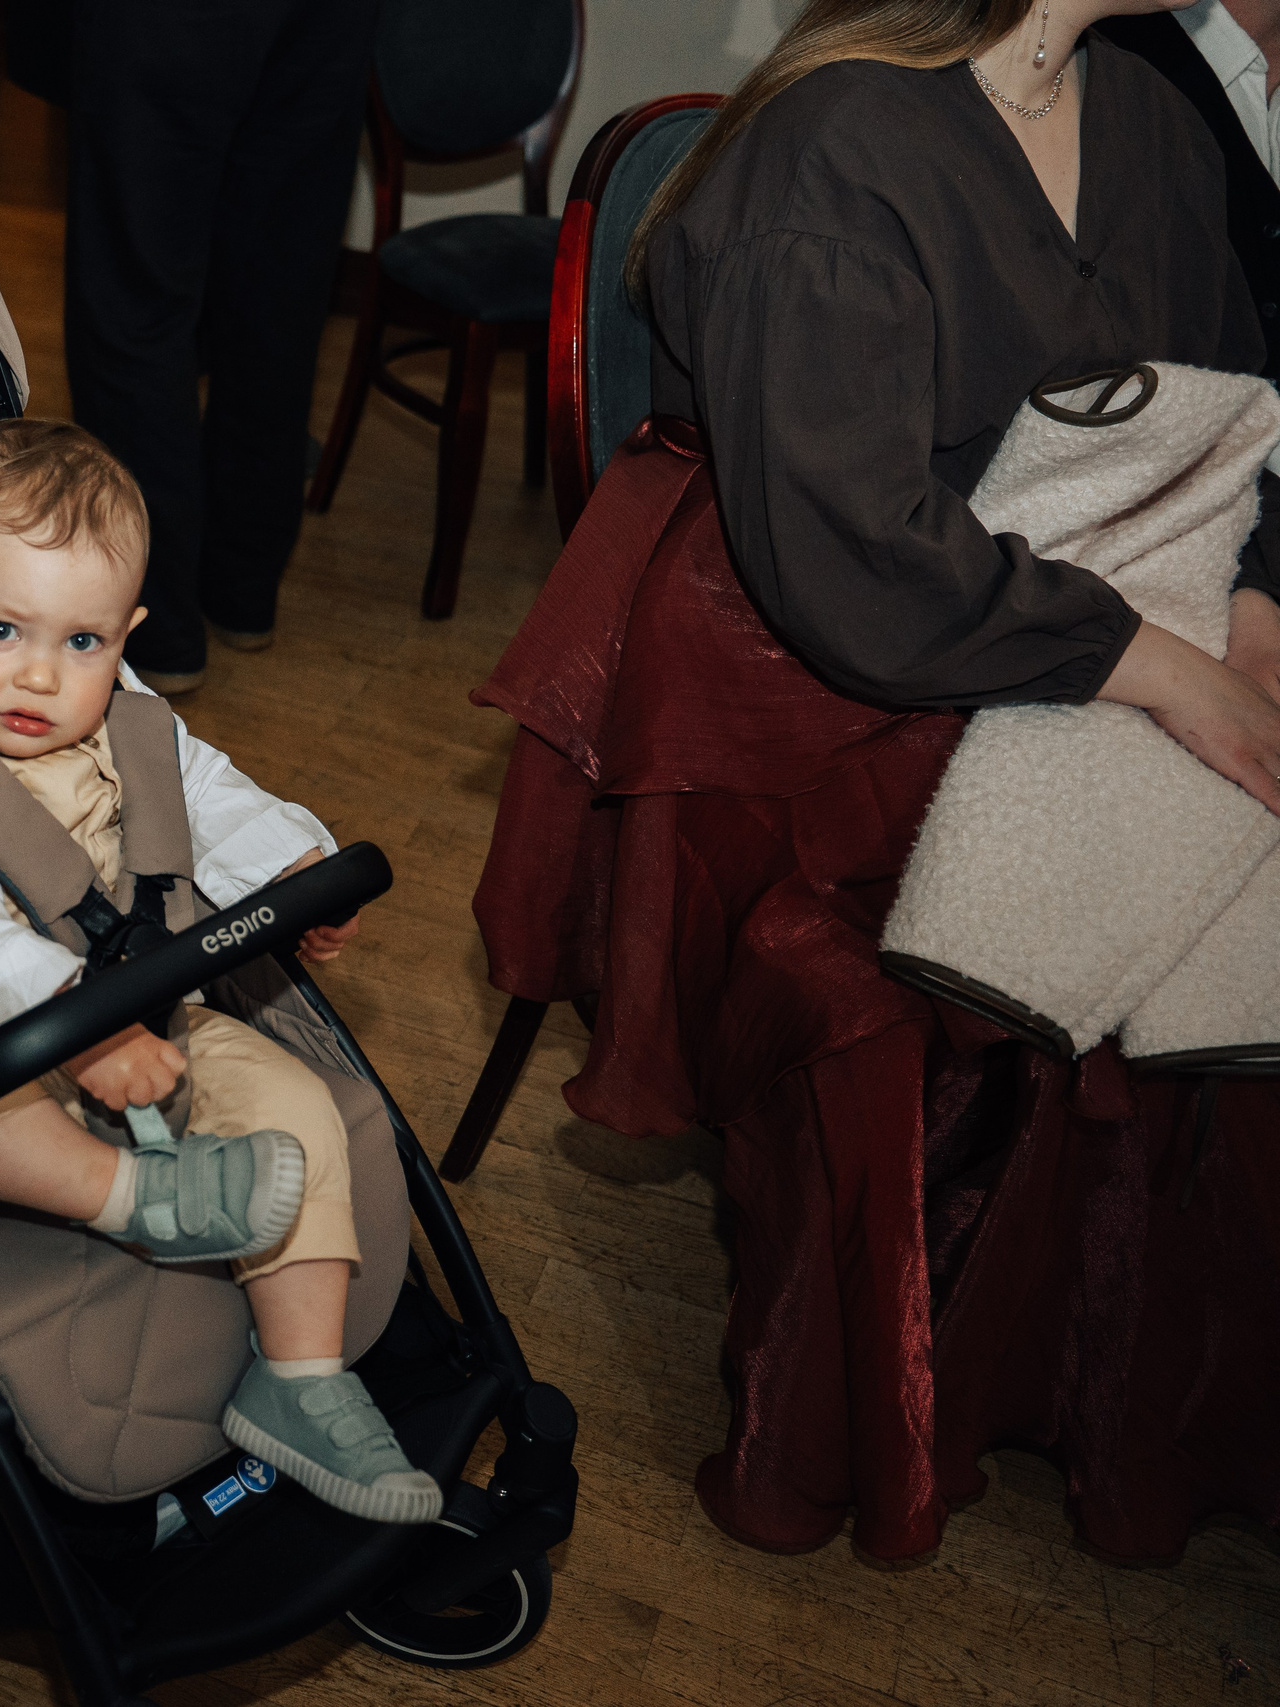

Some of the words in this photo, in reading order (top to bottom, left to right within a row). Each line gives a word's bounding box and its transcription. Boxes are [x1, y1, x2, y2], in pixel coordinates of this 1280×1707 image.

[201, 906, 275, 954] espiro
[226, 1482, 239, 1496] max
[209, 1498, 219, 1507] kg
[217, 1492, 227, 1502] 22
